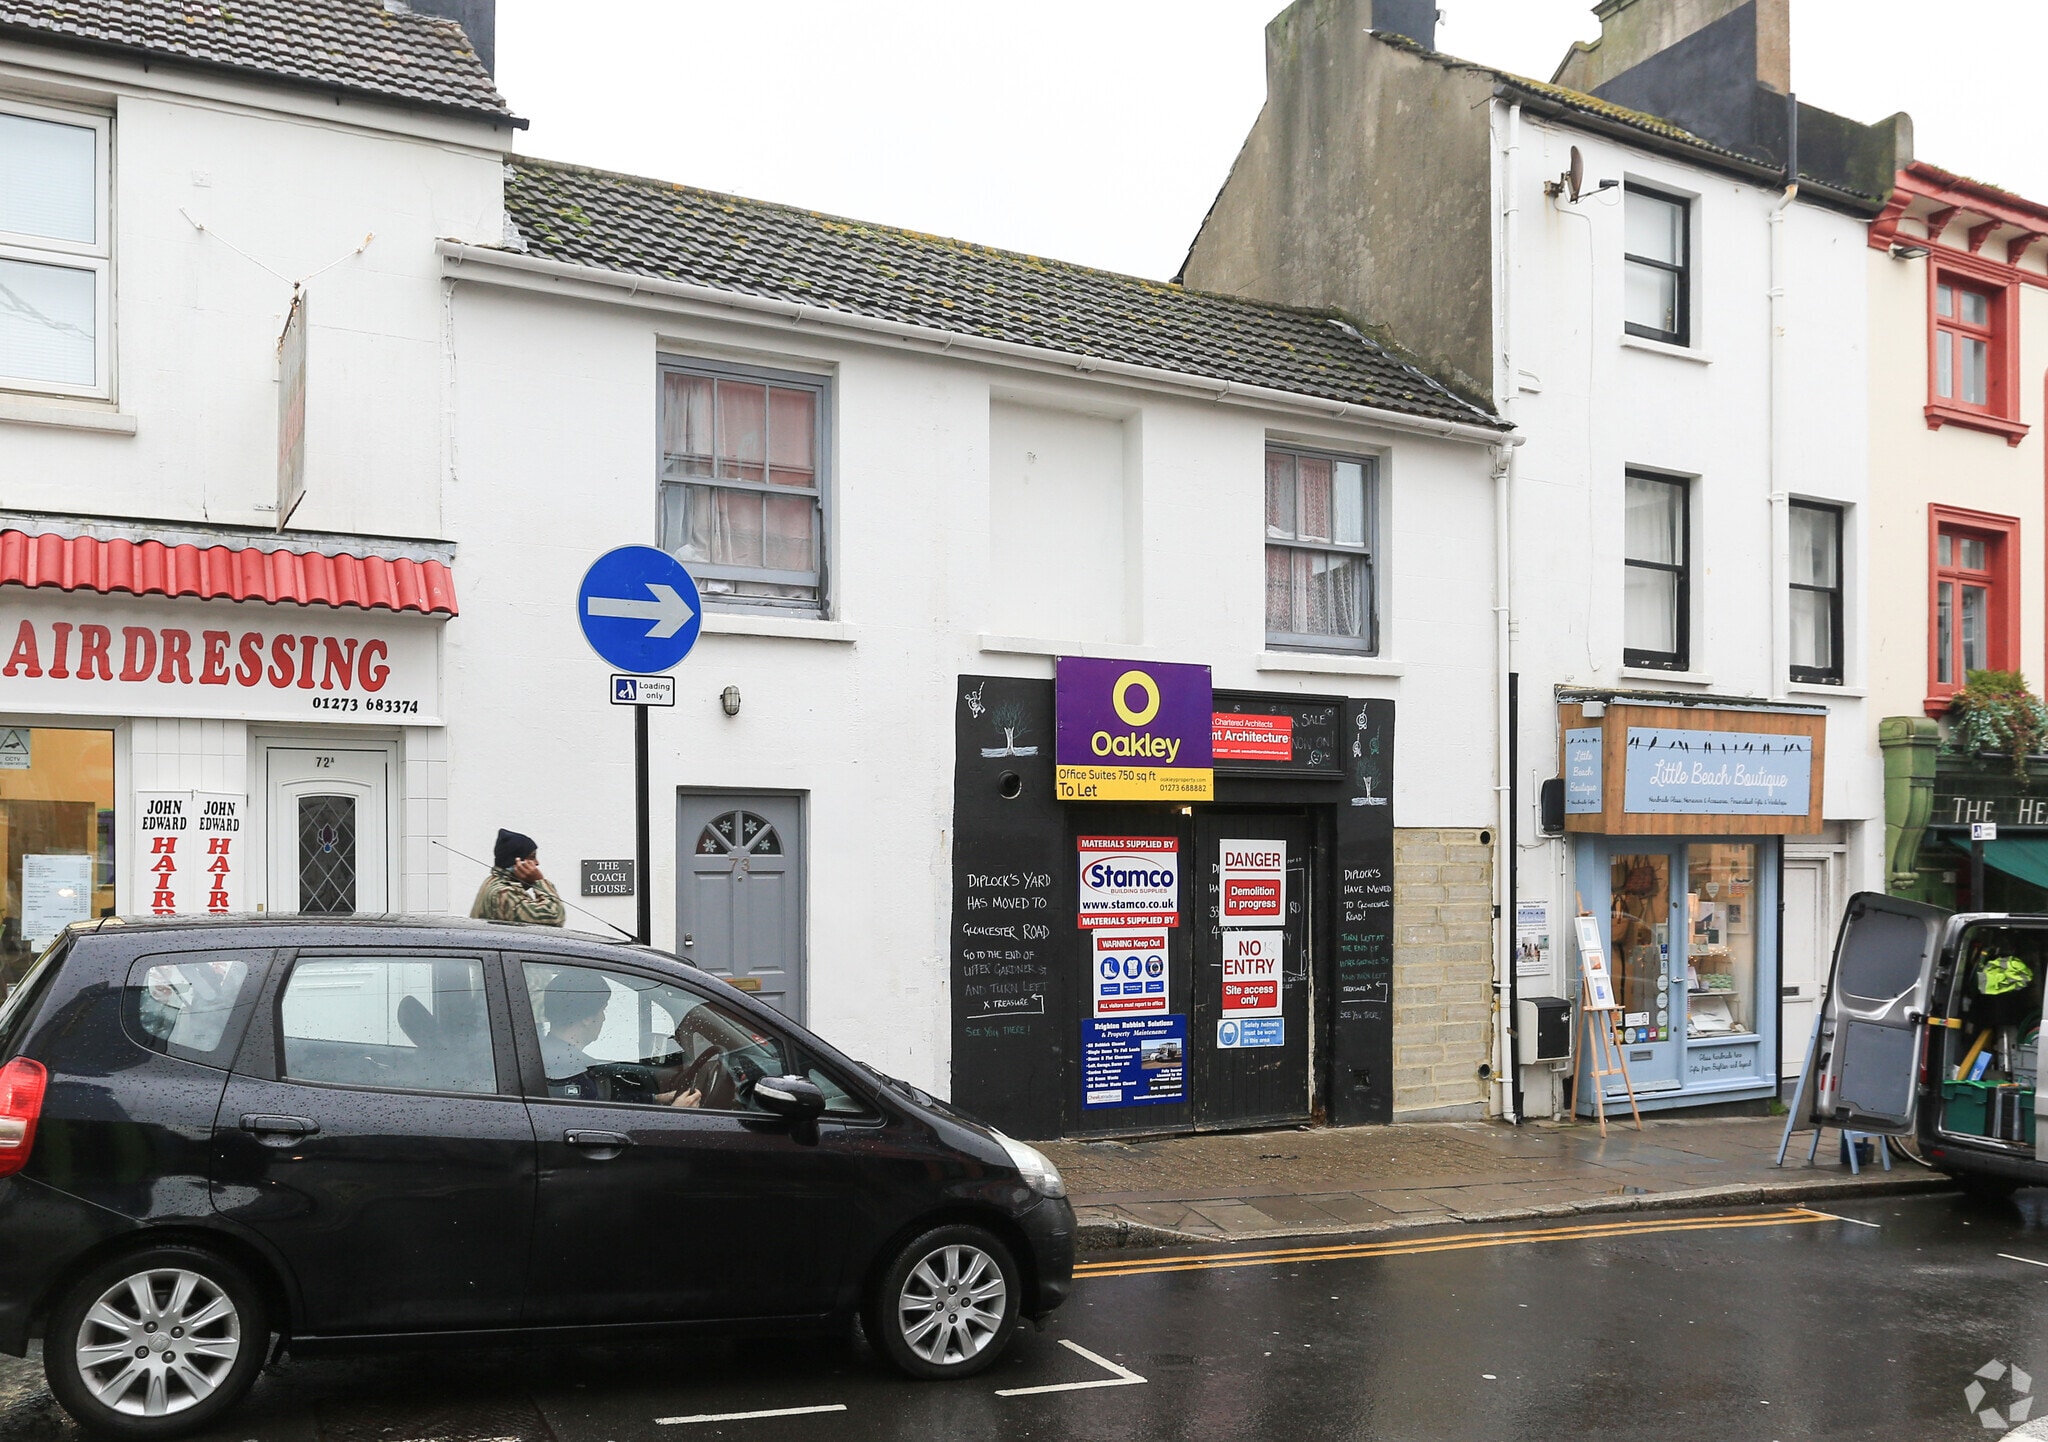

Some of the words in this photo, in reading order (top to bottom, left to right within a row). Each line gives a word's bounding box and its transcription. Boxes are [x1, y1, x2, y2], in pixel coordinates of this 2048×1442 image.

[2, 619, 391, 692] AIRDRESSING
[639, 682, 670, 691] Loading
[646, 691, 663, 700] only
[313, 697, 359, 712] 01273
[366, 698, 419, 714] 683374
[1215, 718, 1244, 727] Chartered
[1245, 720, 1273, 728] Architects
[1224, 730, 1289, 744] Architecture
[1091, 731, 1181, 764] Oakley
[1574, 750, 1593, 762] Little
[1059, 769, 1086, 779] Office
[1089, 770, 1116, 780] Suites
[1118, 770, 1134, 780] 750
[1136, 773, 1147, 782] sq
[1149, 771, 1156, 781] ft
[1573, 766, 1594, 777] Beach
[1650, 758, 1688, 787] Little
[1691, 761, 1732, 786] Beach
[1734, 763, 1788, 796] Boutique
[1059, 782, 1075, 797] To
[1078, 783, 1097, 797] Let
[1160, 784, 1179, 792] 01273
[1570, 782, 1597, 796] Boutique
[147, 800, 182, 815] JOHN
[204, 801, 236, 816] JOHN
[1953, 797, 1994, 823] THE
[2018, 799, 2048, 824] HE
[142, 817, 187, 830] EDWARD
[199, 818, 240, 832] EDWARD
[1126, 840, 1162, 848] SUPPLIED
[729, 857, 750, 871] 73
[1225, 852, 1281, 867] DANGER
[597, 862, 619, 870] THE
[150, 837, 178, 914] HAIR
[207, 838, 232, 914] HAIR
[590, 873, 626, 882] COACH
[1023, 871, 1051, 889] YARD
[1091, 864, 1174, 888] Stamco
[590, 885, 626, 893] HOUSE
[1231, 886, 1275, 896] Demolition
[1344, 885, 1364, 894] HAVE
[1367, 885, 1391, 893] MOVED
[967, 896, 988, 910] HAS
[992, 896, 1029, 909] MOVED
[1032, 897, 1047, 908] TO
[1082, 898, 1174, 909] www.stamco.co.uk
[1228, 899, 1236, 908] in
[1239, 900, 1276, 910] progress
[1343, 901, 1354, 909] TO
[1082, 917, 1124, 925] MATERIALS
[1126, 917, 1162, 925] SUPPLIED
[1164, 916, 1174, 924] BY
[963, 923, 1020, 940] GLOUCESTER
[1023, 924, 1050, 939] ROAD
[1341, 933, 1357, 941] TURN
[1102, 940, 1132, 948] WARNING
[1133, 940, 1148, 948] Keep
[1149, 939, 1160, 947] Out
[1239, 940, 1262, 956] NO
[963, 949, 975, 960] GO
[977, 951, 985, 959] TO
[987, 951, 1002, 959] THE
[1005, 950, 1021, 959] END
[1023, 951, 1035, 960] OF
[1224, 958, 1275, 975] ENTRY
[965, 984, 986, 996] AND
[990, 983, 1018, 994] TURN
[1023, 980, 1048, 992] LEFT
[1225, 985, 1241, 995] Site
[1244, 986, 1273, 994] access
[993, 998, 1029, 1008] TREASURE
[1240, 995, 1259, 1006] only
[966, 1027, 981, 1036] SEE
[1094, 1023, 1120, 1031] Brighton
